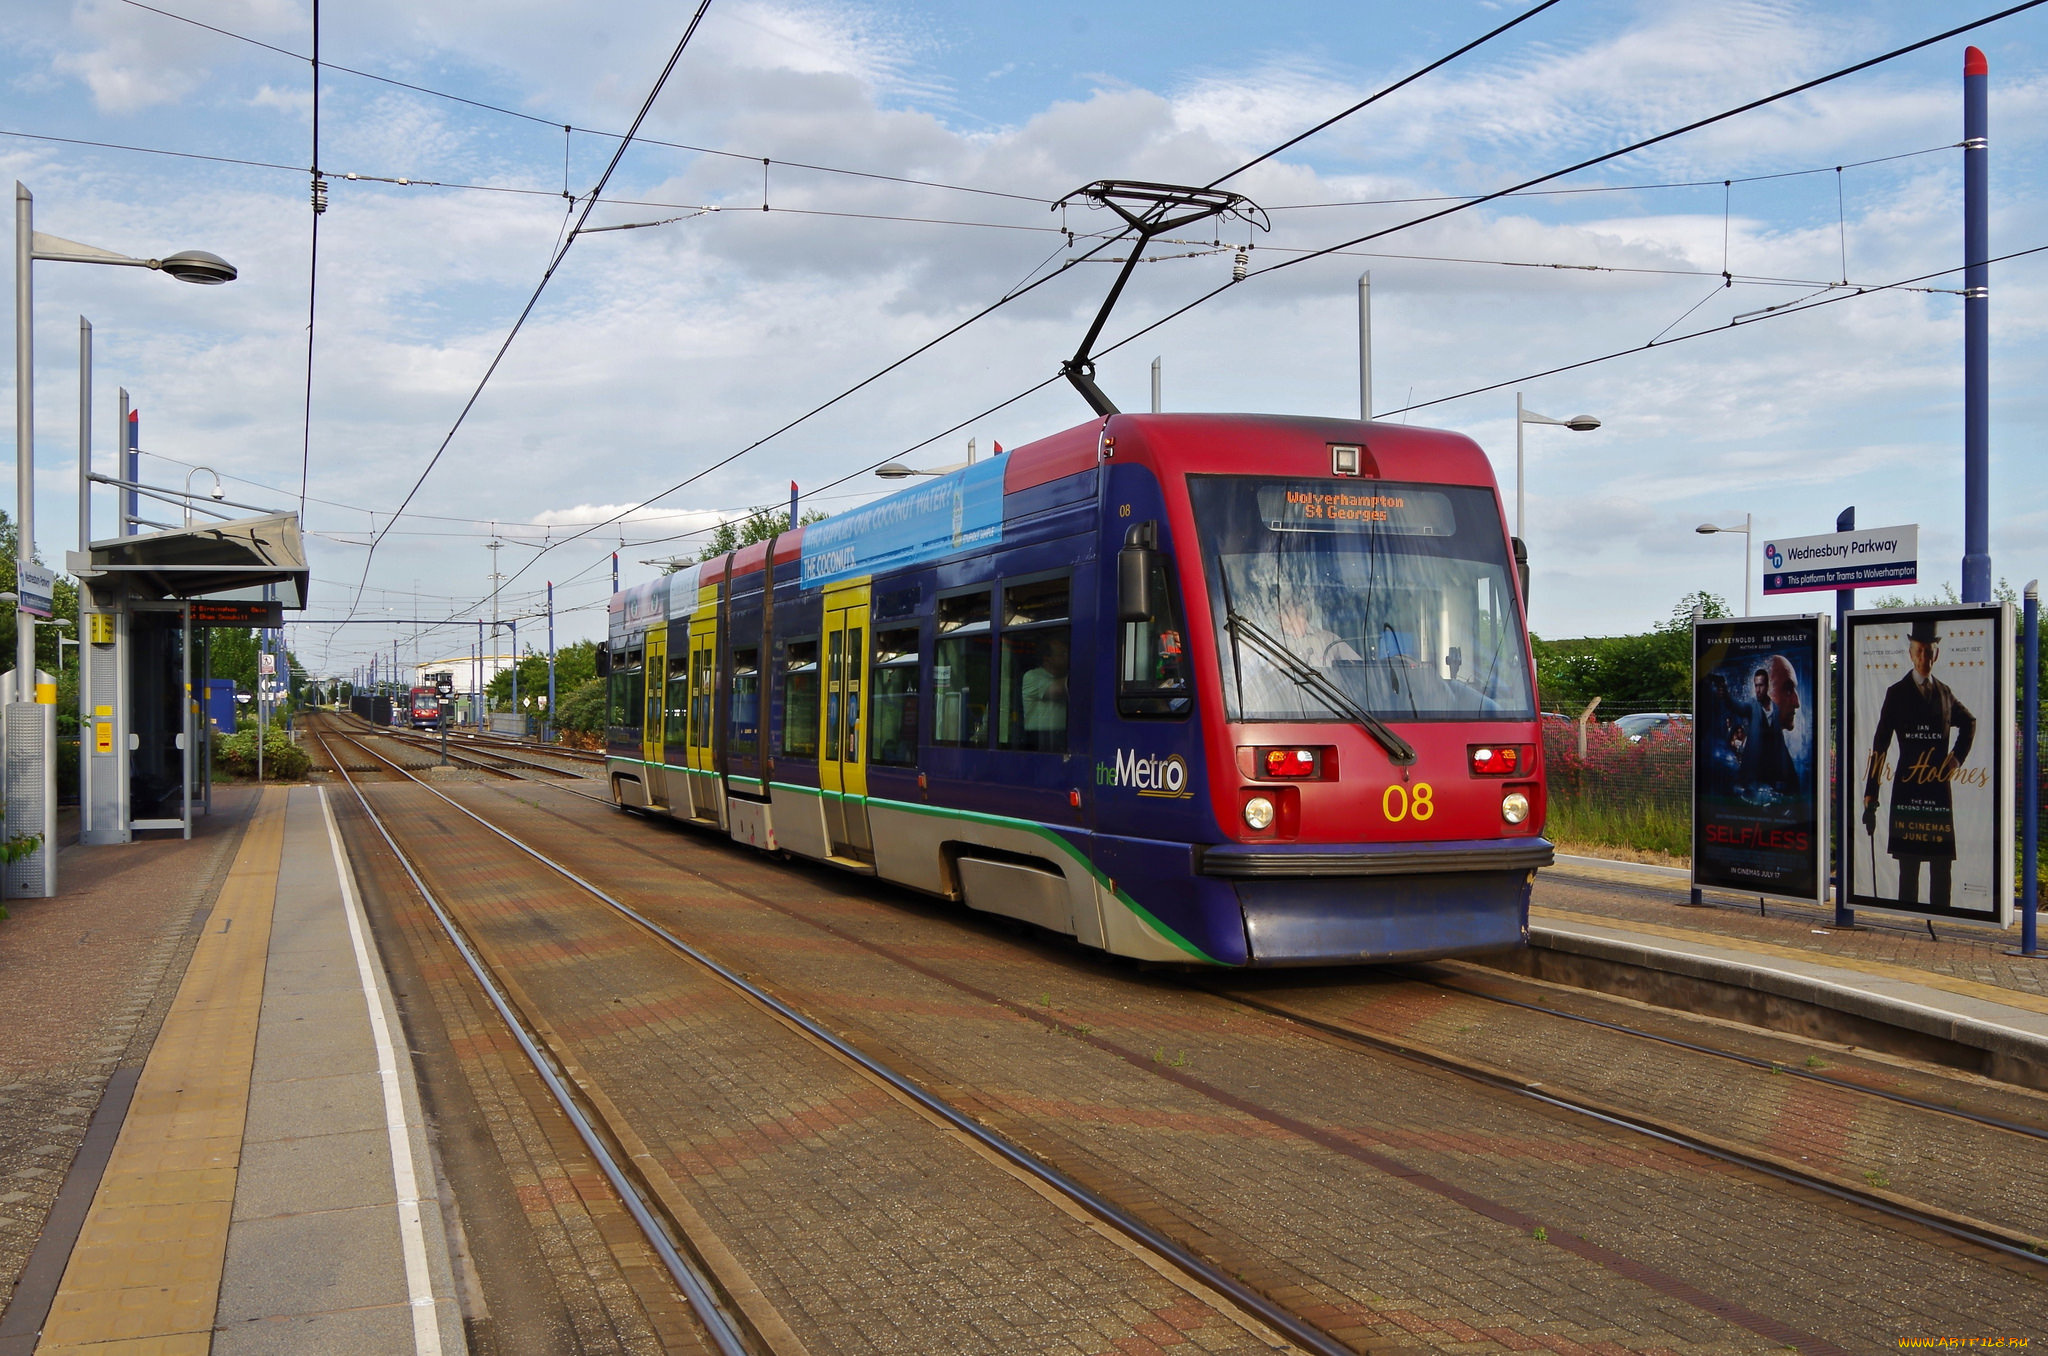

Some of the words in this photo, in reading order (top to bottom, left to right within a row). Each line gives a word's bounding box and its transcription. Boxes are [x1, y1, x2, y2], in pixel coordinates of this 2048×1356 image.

[854, 510, 870, 535] OUR
[873, 493, 916, 529] COCONUT
[917, 481, 952, 514] WATER?
[1287, 491, 1404, 508] Wolverhampton
[1120, 504, 1131, 518] 08
[1305, 504, 1322, 518] St
[1327, 505, 1387, 522] Georges
[1788, 543, 1849, 560] Wednesbury
[1851, 539, 1898, 554] Parkway
[804, 557, 816, 579] THE
[1788, 575, 1800, 585] This
[1800, 573, 1826, 586] platform
[1826, 571, 1835, 581] for
[1836, 571, 1855, 580] Trams
[1856, 570, 1863, 579] to
[1863, 566, 1916, 579] Wolverhampton
[1724, 636, 1755, 644] REYNOLDS
[1763, 635, 1775, 643] BEN
[1862, 748, 1895, 785] Mr
[1902, 746, 1990, 788] Holmes
[1383, 782, 1434, 823] 08
[1895, 820, 1905, 829] IN
[1908, 821, 1951, 832] CINEMAS
[1902, 832, 1929, 842] JUNE
[1738, 868, 1760, 877] CINEMAS
[1761, 870, 1774, 878] JULY
